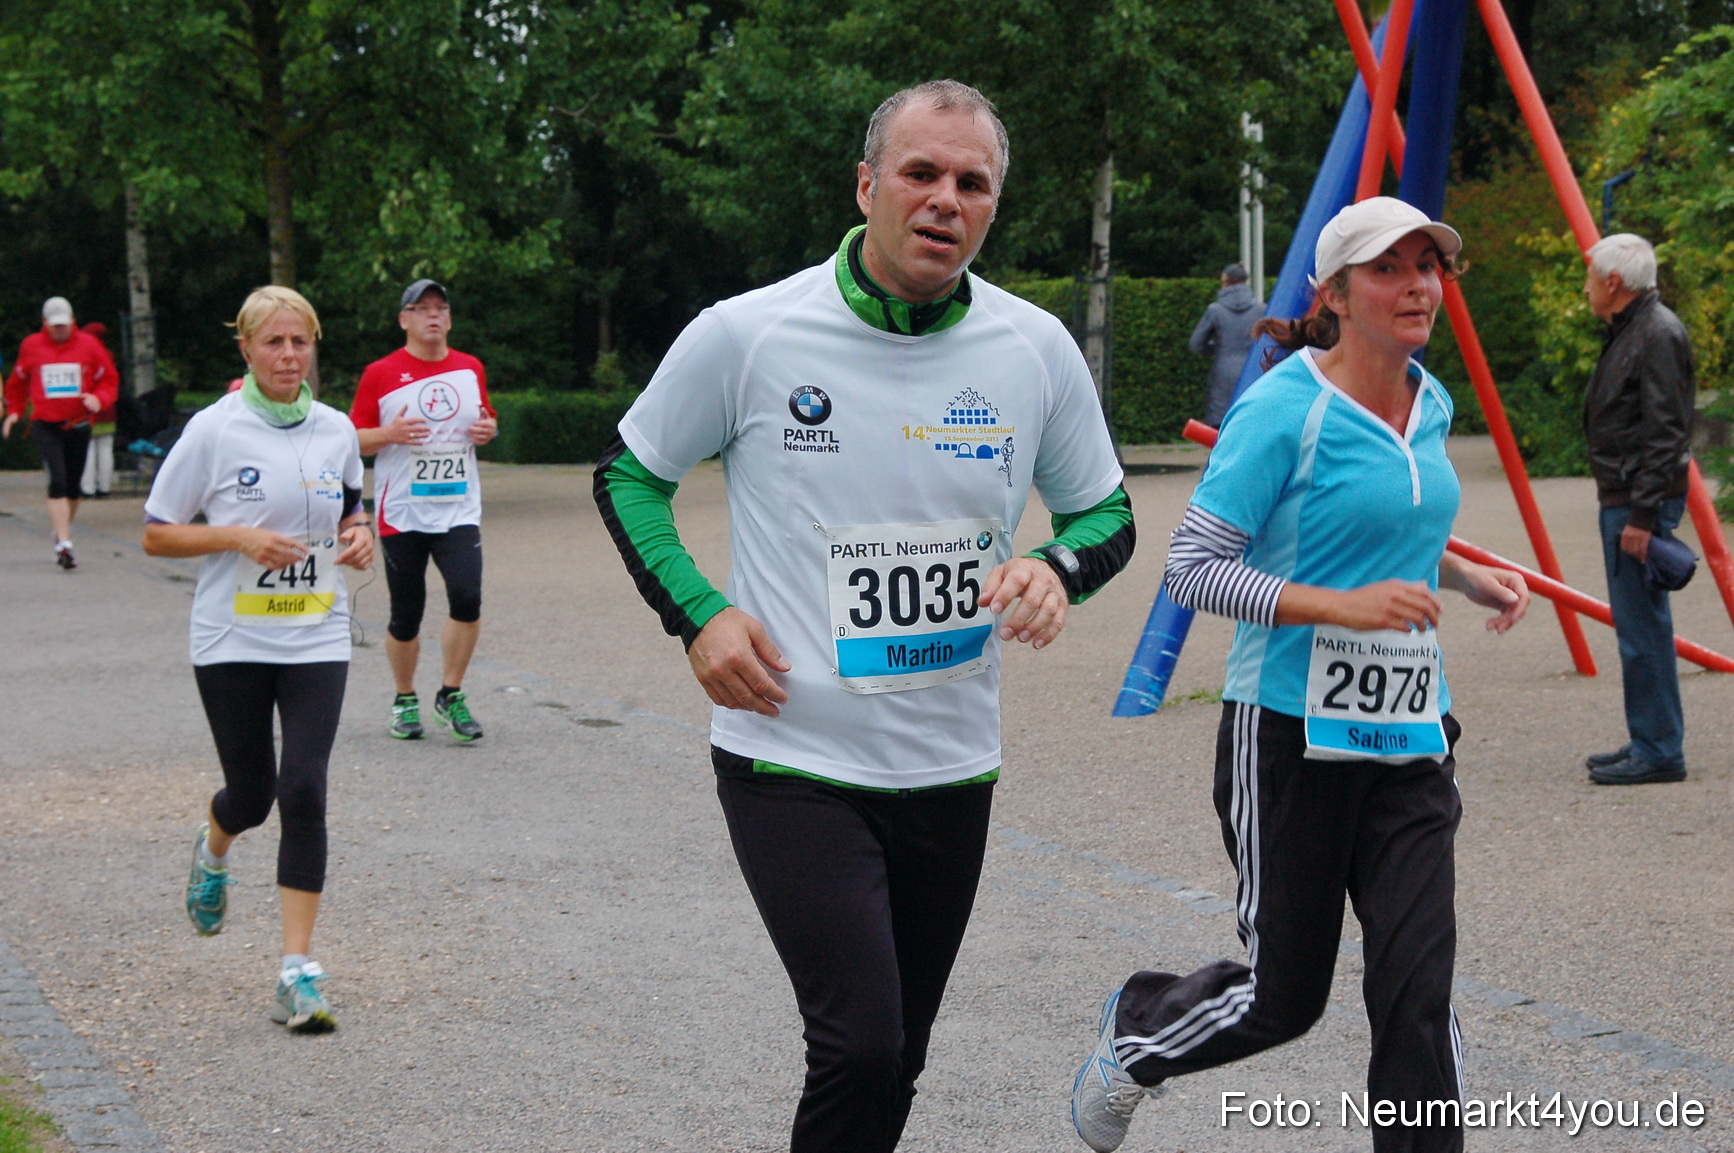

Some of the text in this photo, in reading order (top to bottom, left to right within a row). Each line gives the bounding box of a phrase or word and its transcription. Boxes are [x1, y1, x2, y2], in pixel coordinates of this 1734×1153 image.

[792, 386, 828, 401] BMW
[783, 428, 840, 443] PARTL
[901, 425, 1016, 441] 14. Neumarkter Stadtlauf
[783, 441, 840, 454] Neumarkt
[416, 458, 466, 480] 2724
[831, 537, 972, 559] PARTL Neumarkt
[847, 559, 981, 629] 3035
[266, 598, 306, 613] Astrid
[838, 626, 846, 637] D
[886, 641, 954, 668] Martin
[1315, 636, 1430, 660] PARTL Neumarkt
[1322, 660, 1432, 716] 2978
[1347, 727, 1409, 751] Sabine
